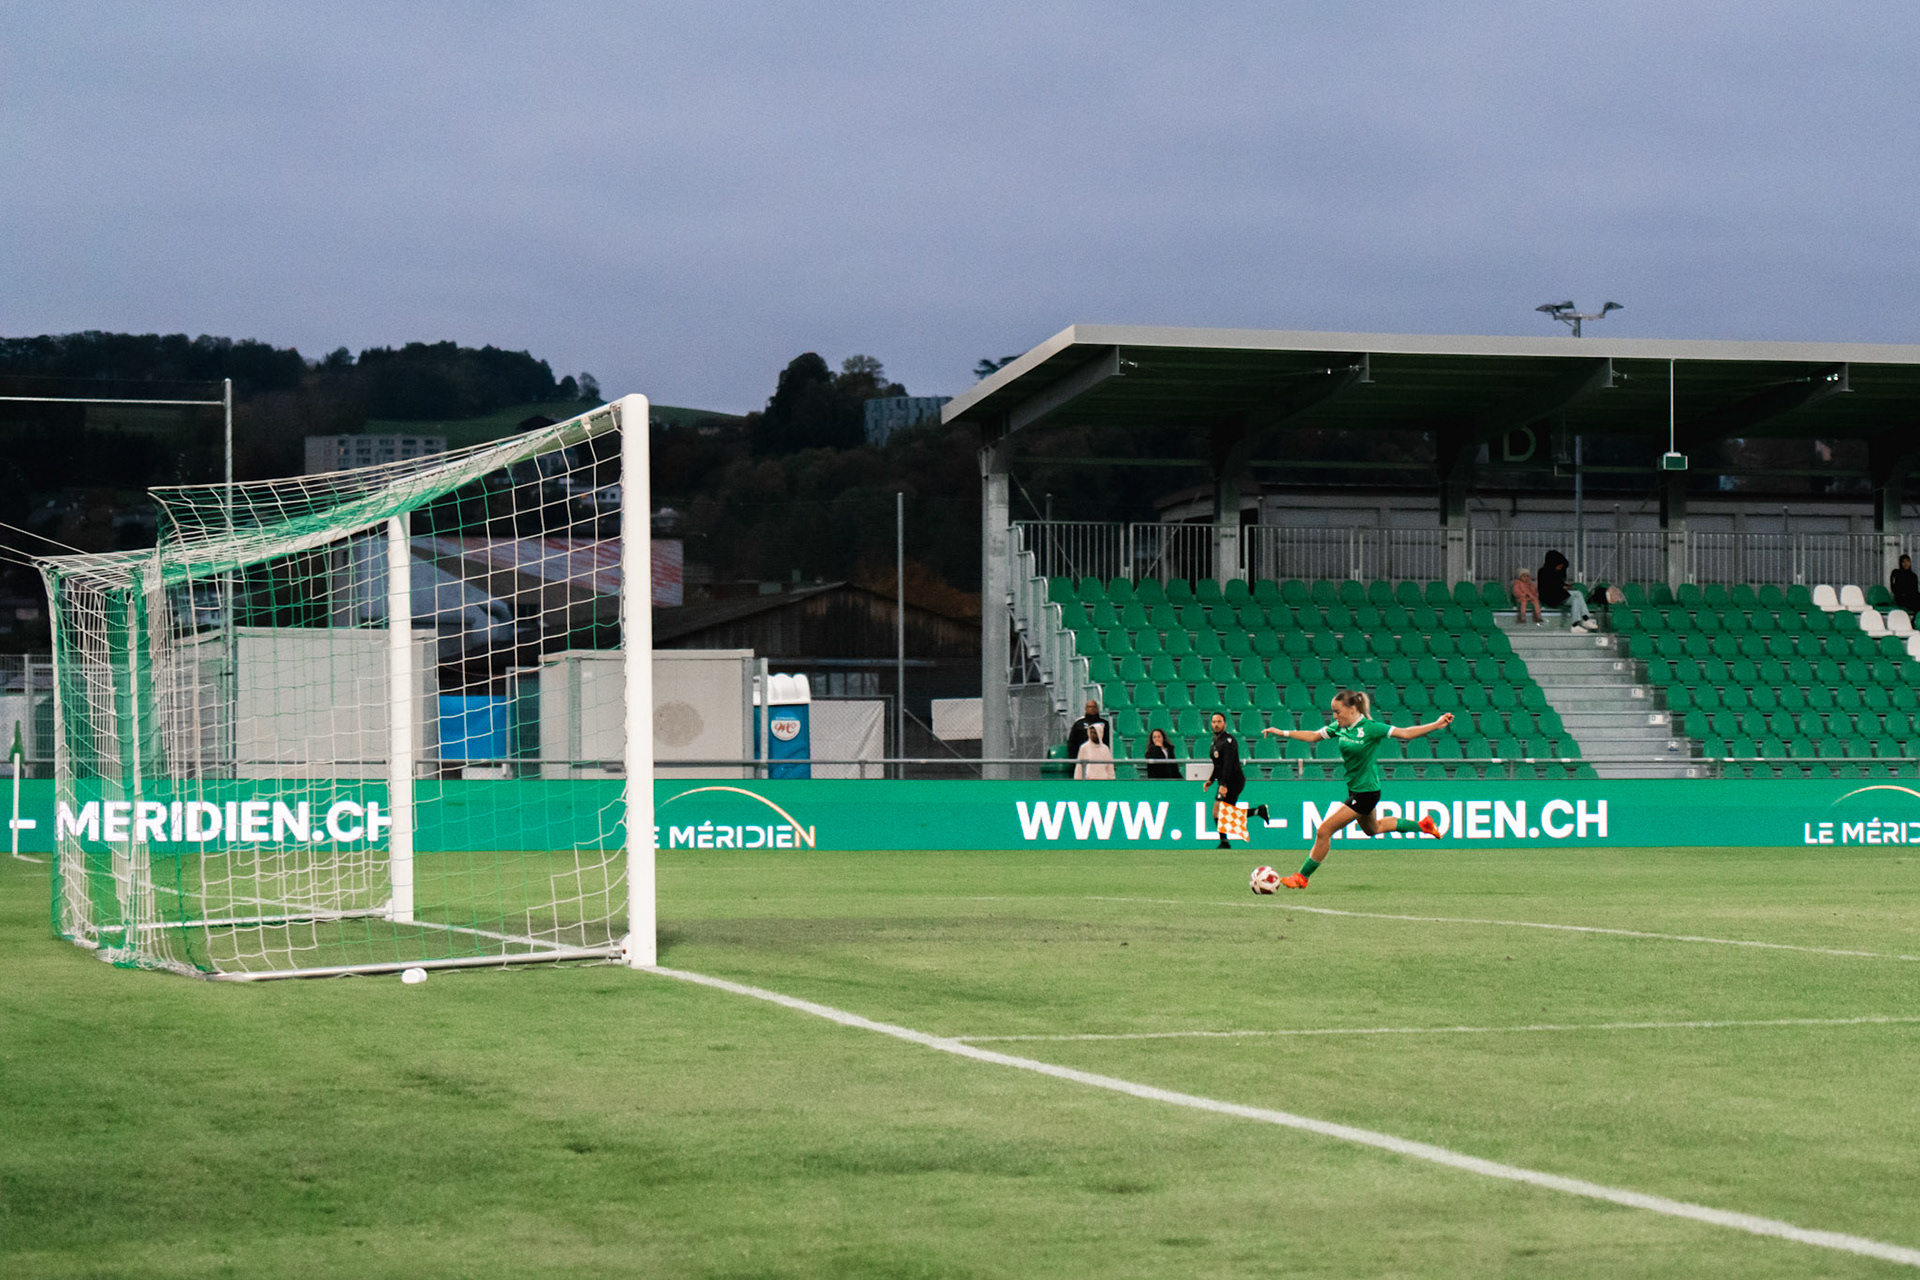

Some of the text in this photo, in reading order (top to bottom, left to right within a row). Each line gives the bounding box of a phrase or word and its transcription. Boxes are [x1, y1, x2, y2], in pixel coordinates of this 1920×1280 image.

[1503, 424, 1537, 462] D
[669, 820, 816, 849] MÉRIDIEN
[1015, 801, 1183, 841] WWW.
[1804, 822, 1834, 844] LE
